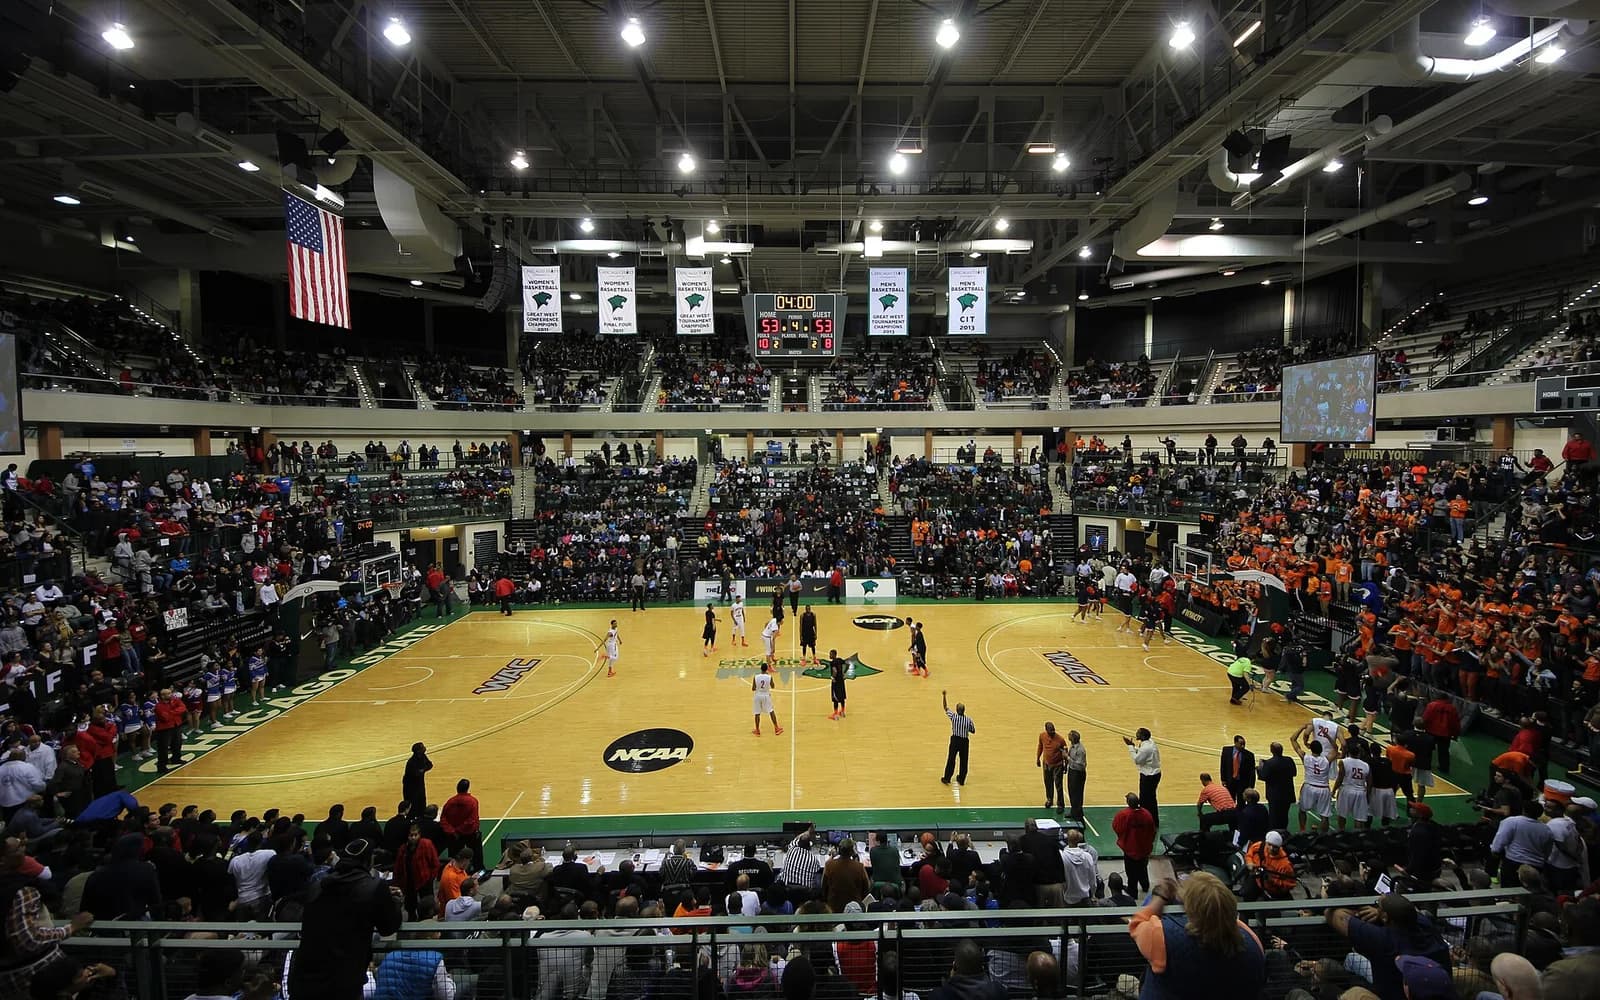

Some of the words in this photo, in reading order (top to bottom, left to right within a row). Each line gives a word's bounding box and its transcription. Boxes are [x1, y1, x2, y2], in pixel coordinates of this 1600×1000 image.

[777, 295, 813, 309] 04:00
[762, 319, 779, 332] 53
[791, 322, 798, 331] 4
[815, 319, 832, 332] 53
[959, 315, 975, 323] CIT
[758, 338, 769, 349] 10
[825, 338, 832, 349] 8
[1343, 450, 1385, 460] WHITNEY
[1388, 450, 1425, 461] YOUNG
[83, 643, 98, 666] F
[1042, 651, 1110, 686] WAC
[46, 669, 62, 694] F
[472, 658, 541, 695] WAC
[138, 669, 358, 773] CHICAGO
[350, 624, 446, 665] STATE
[608, 747, 689, 762] NCAA
[1313, 764, 1321, 775] 5
[1352, 767, 1363, 780] 25
